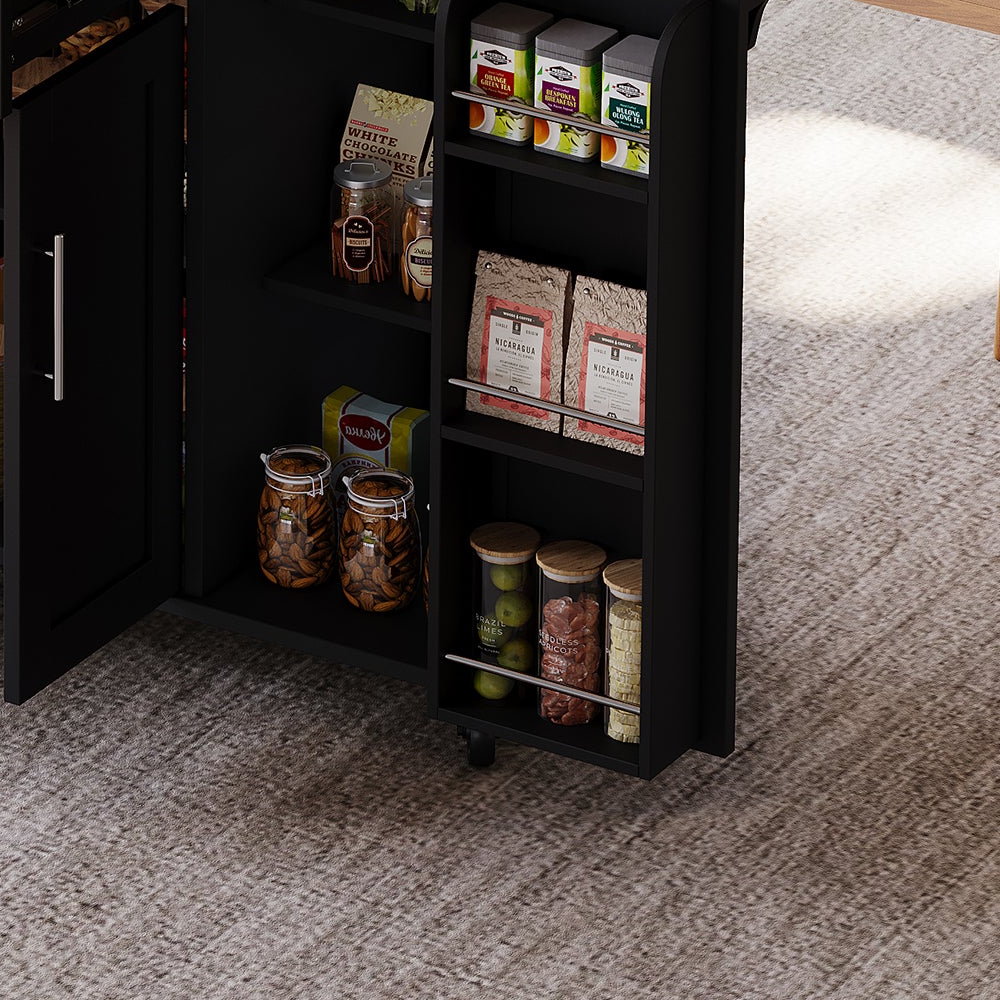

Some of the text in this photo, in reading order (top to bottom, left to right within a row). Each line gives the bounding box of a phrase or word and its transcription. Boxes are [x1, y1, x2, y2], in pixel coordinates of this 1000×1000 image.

[480, 78, 499, 89] GREEN
[500, 83, 511, 92] TEA
[484, 73, 507, 84] ORANGE
[544, 95, 577, 108] BREAKFAST
[545, 89, 576, 102] BESPOKEN
[612, 111, 632, 122] OLONG
[633, 116, 644, 125] TEA
[615, 106, 641, 118] WULONG
[347, 126, 398, 148] WHITE
[344, 138, 418, 164] CHOCOLATE
[494, 337, 536, 355] NICARAGUA
[593, 363, 635, 381] NICARAGUA
[475, 612, 506, 628] BRAZIL
[476, 623, 503, 636] LIMES
[538, 629, 579, 646] SEEDLESS
[538, 638, 578, 655] APRICOTS
